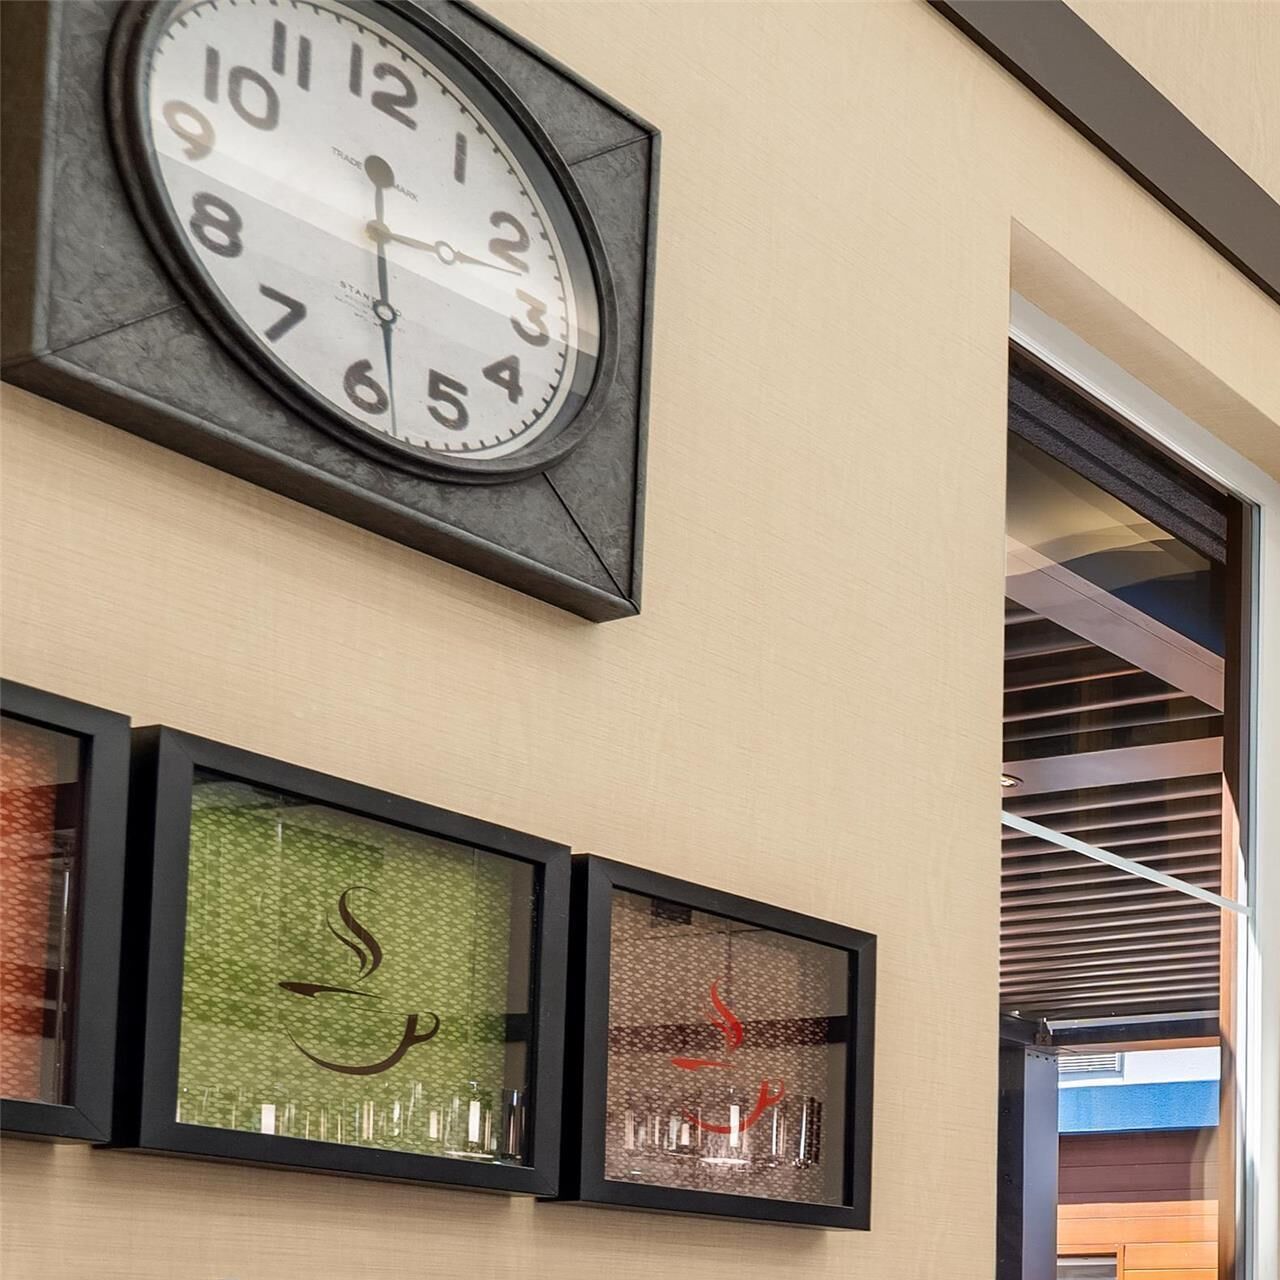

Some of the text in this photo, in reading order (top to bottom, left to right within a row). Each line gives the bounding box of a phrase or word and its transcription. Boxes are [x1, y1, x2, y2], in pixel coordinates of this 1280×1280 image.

[272, 19, 312, 91] 11
[203, 46, 280, 131] 10
[348, 43, 419, 130] 12
[162, 99, 216, 161] 9
[454, 132, 468, 184] 1
[189, 192, 243, 258] 8
[489, 211, 531, 273] 2
[259, 284, 307, 343] 7
[510, 288, 550, 348] 3
[343, 359, 390, 415] 6
[427, 370, 469, 431] 5
[483, 354, 524, 404] 4
